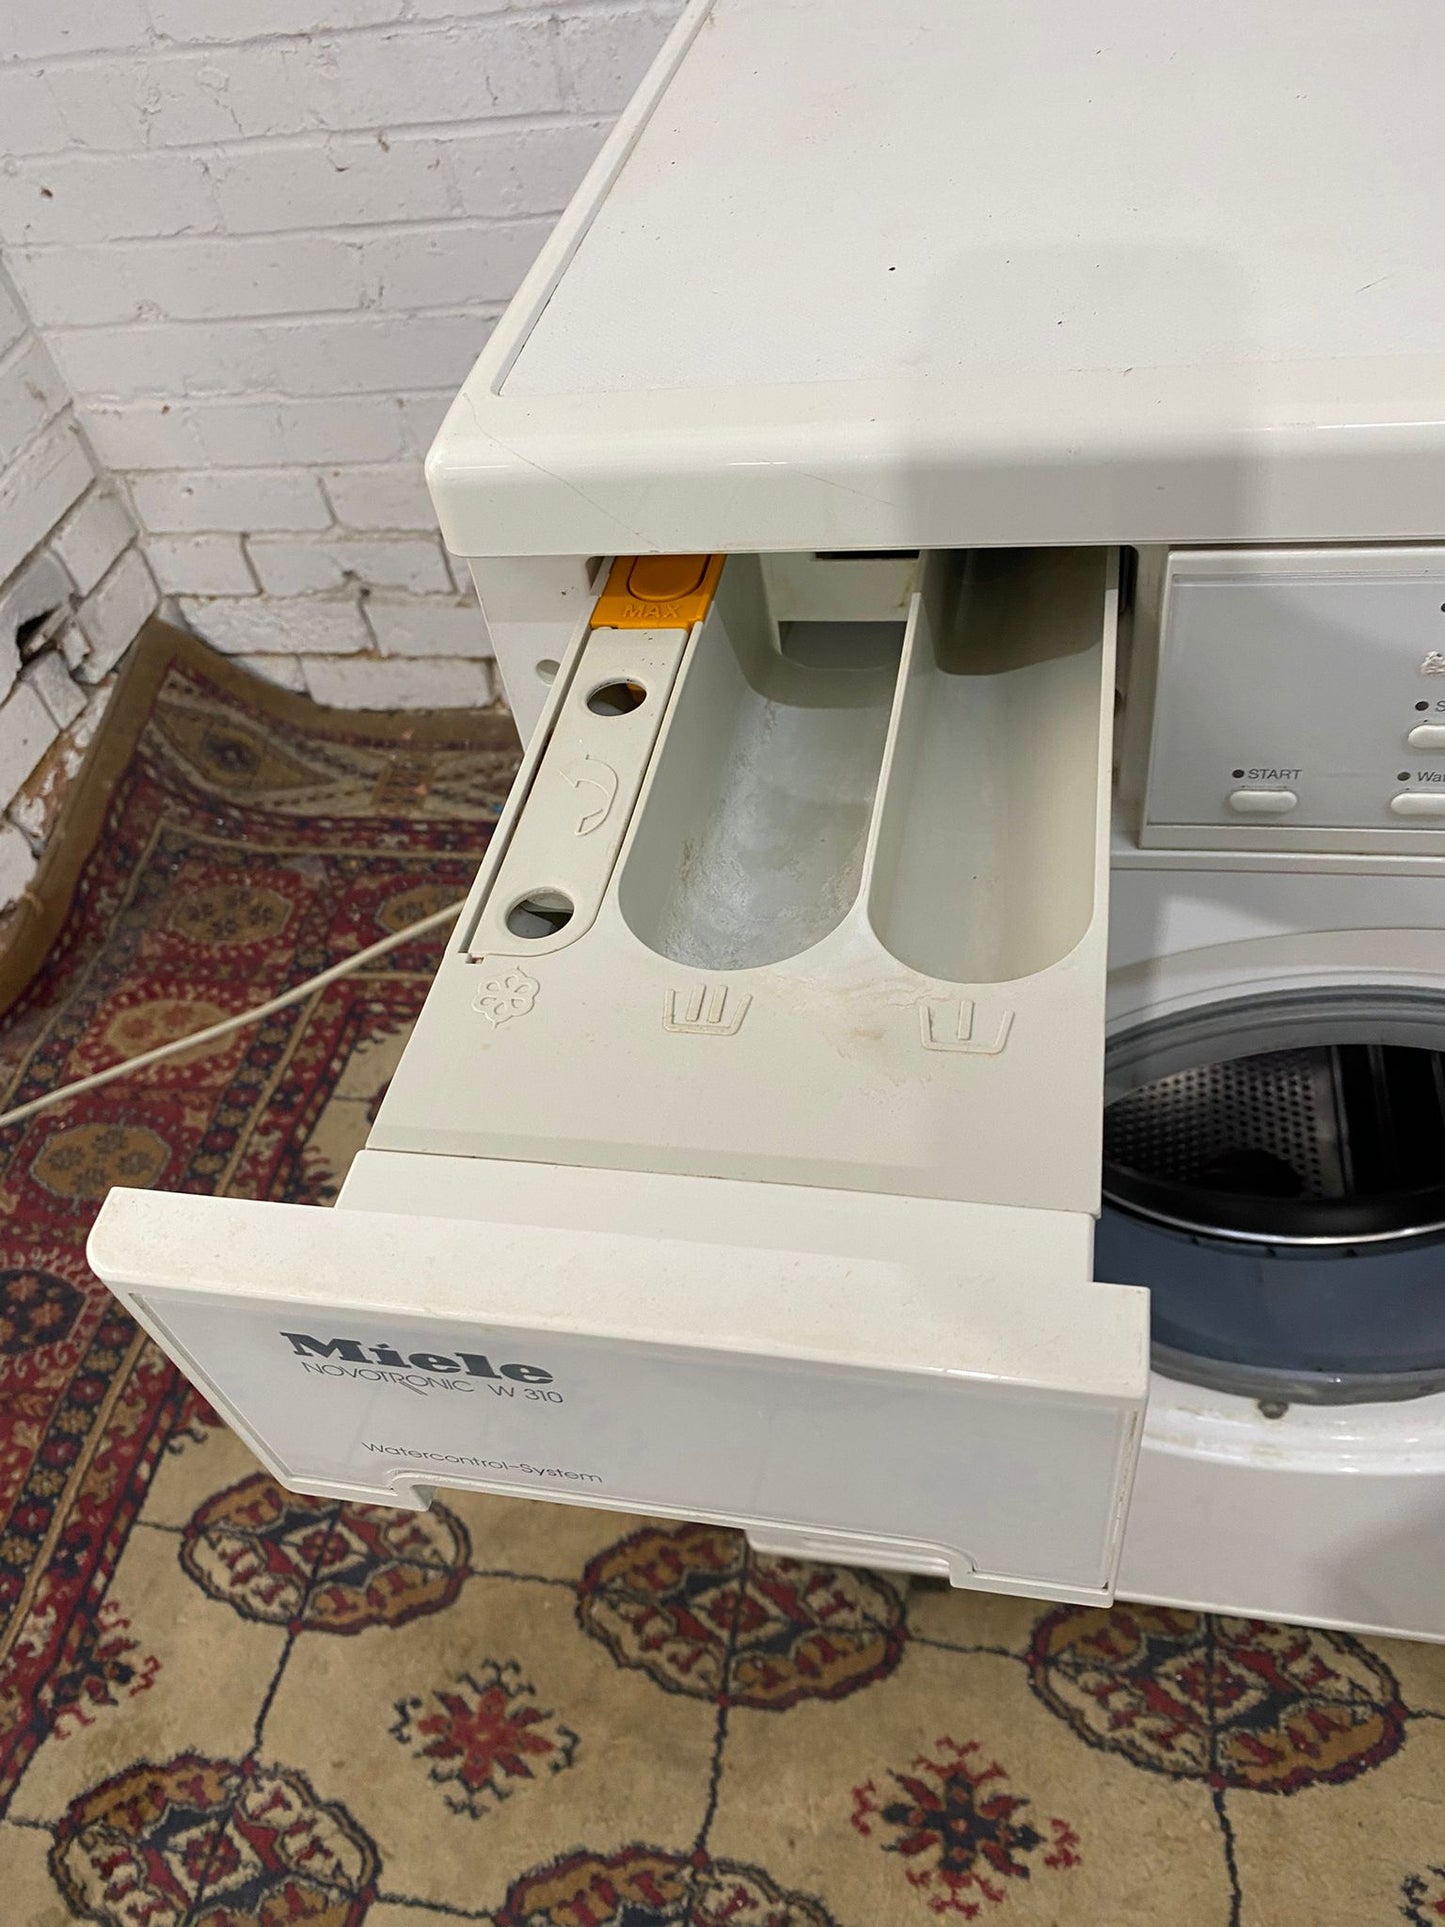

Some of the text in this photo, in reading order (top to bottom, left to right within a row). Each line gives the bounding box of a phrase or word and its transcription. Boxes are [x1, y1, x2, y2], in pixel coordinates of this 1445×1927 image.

[624, 603, 680, 618] MAX
[1248, 768, 1303, 780] START
[279, 1332, 554, 1384] Miele
[301, 1361, 564, 1404] NOVOTRONIC W 310
[361, 1441, 603, 1484] Watercontrol-System
